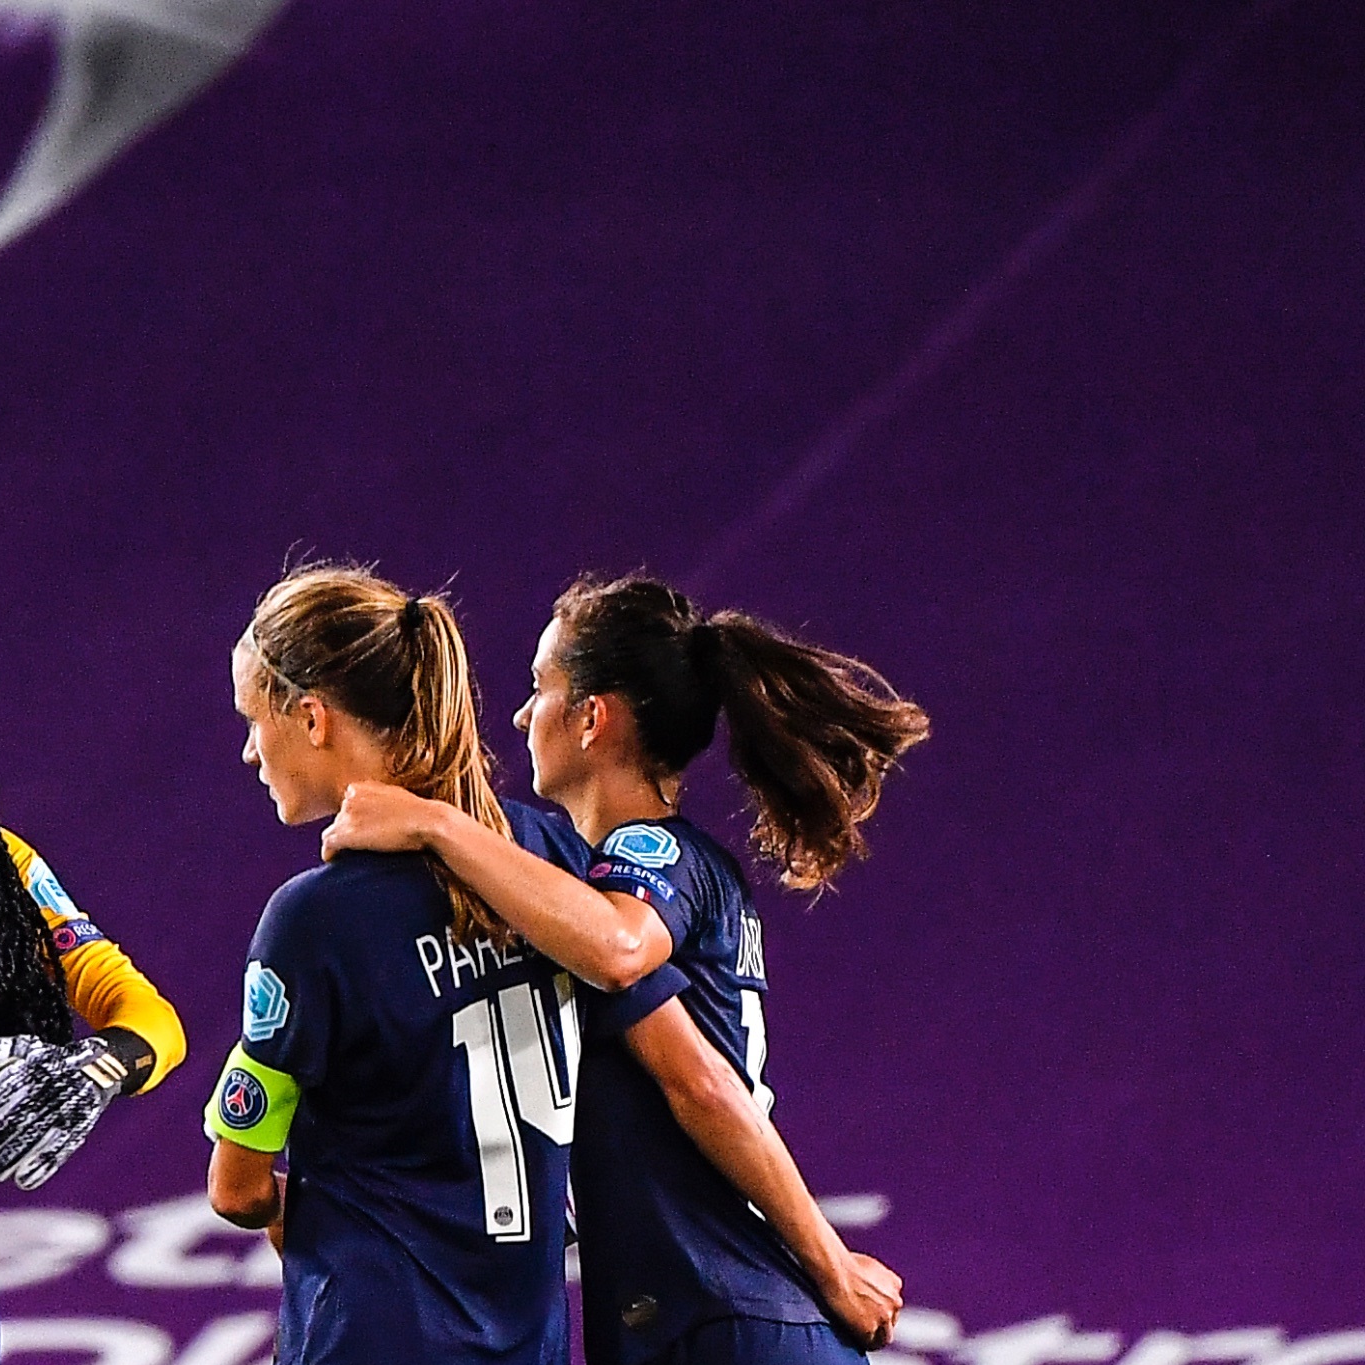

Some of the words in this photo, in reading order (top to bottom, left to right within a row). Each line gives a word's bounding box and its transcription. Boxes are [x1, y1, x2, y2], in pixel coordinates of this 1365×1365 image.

[612, 864, 675, 901] RESPECT
[231, 1072, 259, 1097] PARIS
[452, 967, 582, 1242] 14
